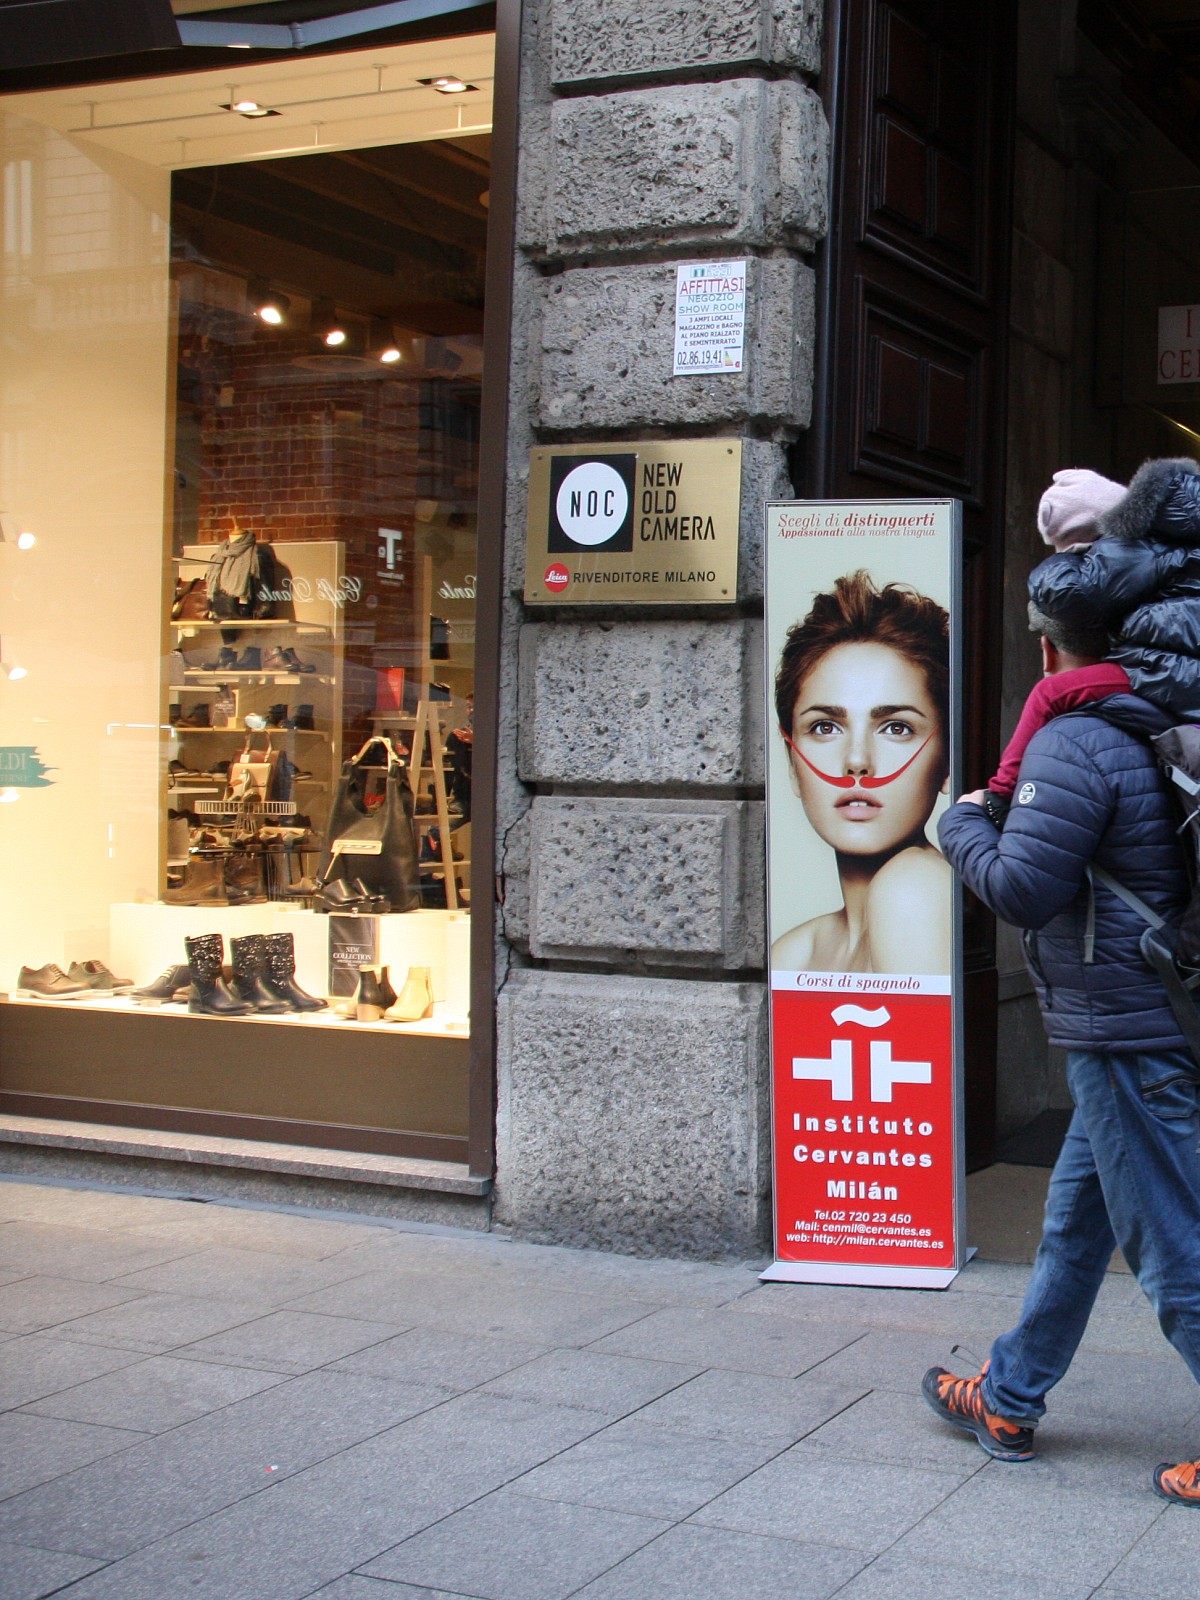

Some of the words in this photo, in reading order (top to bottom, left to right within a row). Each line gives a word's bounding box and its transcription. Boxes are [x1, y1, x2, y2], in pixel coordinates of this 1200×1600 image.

[680, 277, 744, 294] AFFITTASI
[688, 293, 734, 303] NEGOZIO
[680, 305, 709, 313] SHOW
[713, 303, 743, 311] ROOM
[677, 350, 722, 365] 02.86.19.41
[643, 463, 682, 487] NEW
[570, 490, 614, 517] NOC
[642, 491, 676, 514] OLD
[640, 516, 715, 541] CAMERA
[778, 513, 821, 530] Scegli
[825, 513, 839, 527] di
[844, 512, 935, 530] distinguerti
[778, 528, 844, 539] Appassionati
[846, 527, 865, 537] alla
[869, 528, 900, 536] nostra
[903, 527, 935, 538] lingua
[545, 570, 567, 582] Leica
[574, 572, 658, 583] RIVENDITORE
[665, 571, 715, 582] MILANO
[797, 973, 833, 987] Corsi
[838, 975, 852, 987] di
[856, 977, 920, 991] spagnolo
[793, 1113, 933, 1136] Instituto
[793, 1145, 932, 1168] Cervantes
[827, 1179, 898, 1201] Milán
[814, 1210, 845, 1220] Tel.02
[849, 1212, 869, 1222] 720
[872, 1213, 887, 1223] 23
[890, 1214, 911, 1224] 450
[795, 1221, 820, 1231] Mail:
[822, 1223, 931, 1236] cenmil@cervantes.es
[786, 1233, 810, 1242] web:
[812, 1234, 944, 1249] http://milan.cervantes.es
